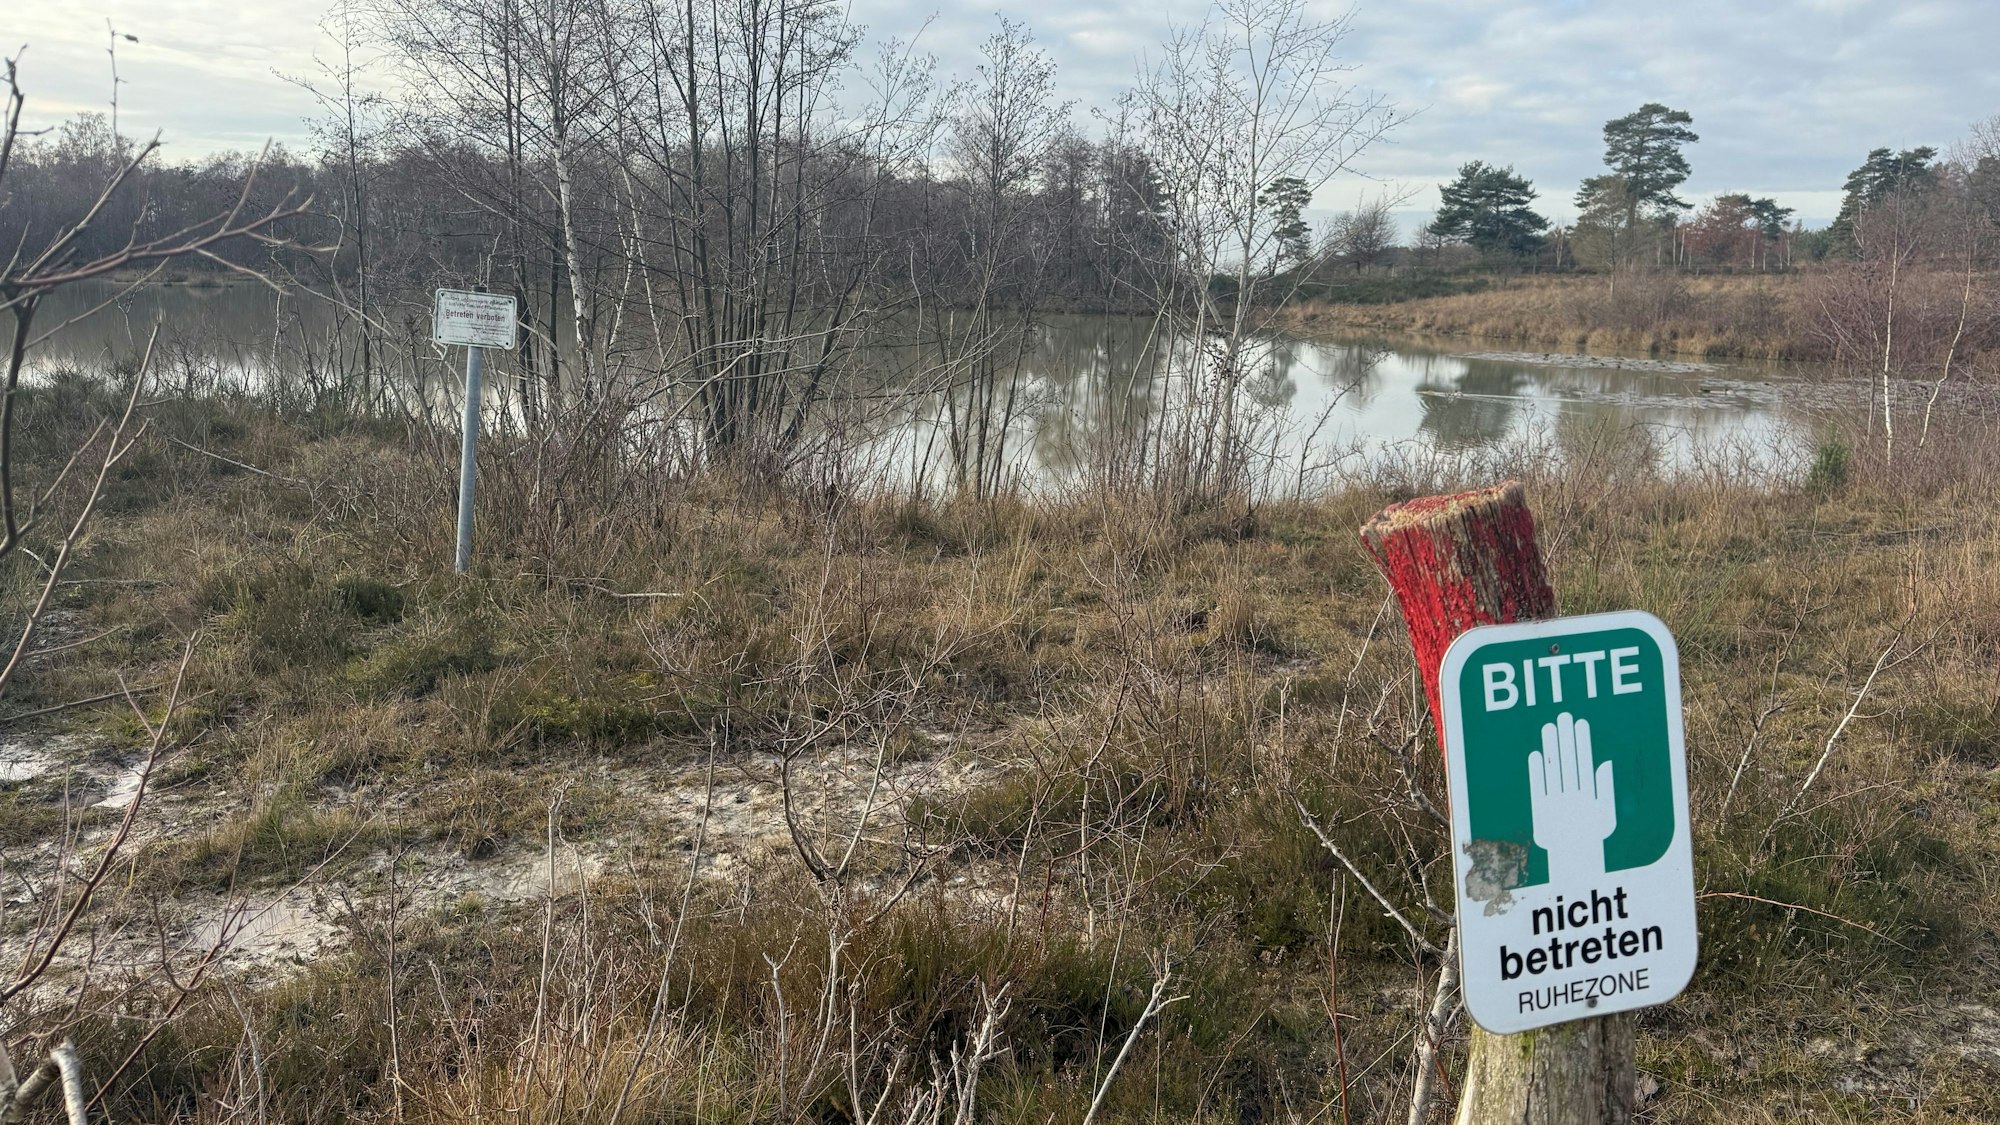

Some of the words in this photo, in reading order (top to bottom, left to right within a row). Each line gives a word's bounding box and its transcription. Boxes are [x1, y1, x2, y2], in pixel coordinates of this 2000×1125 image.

[1482, 646, 1643, 712] BITTE
[1532, 886, 1628, 935] nicht
[1500, 925, 1663, 981] betreten
[1519, 968, 1650, 1014] RUHEZONE
